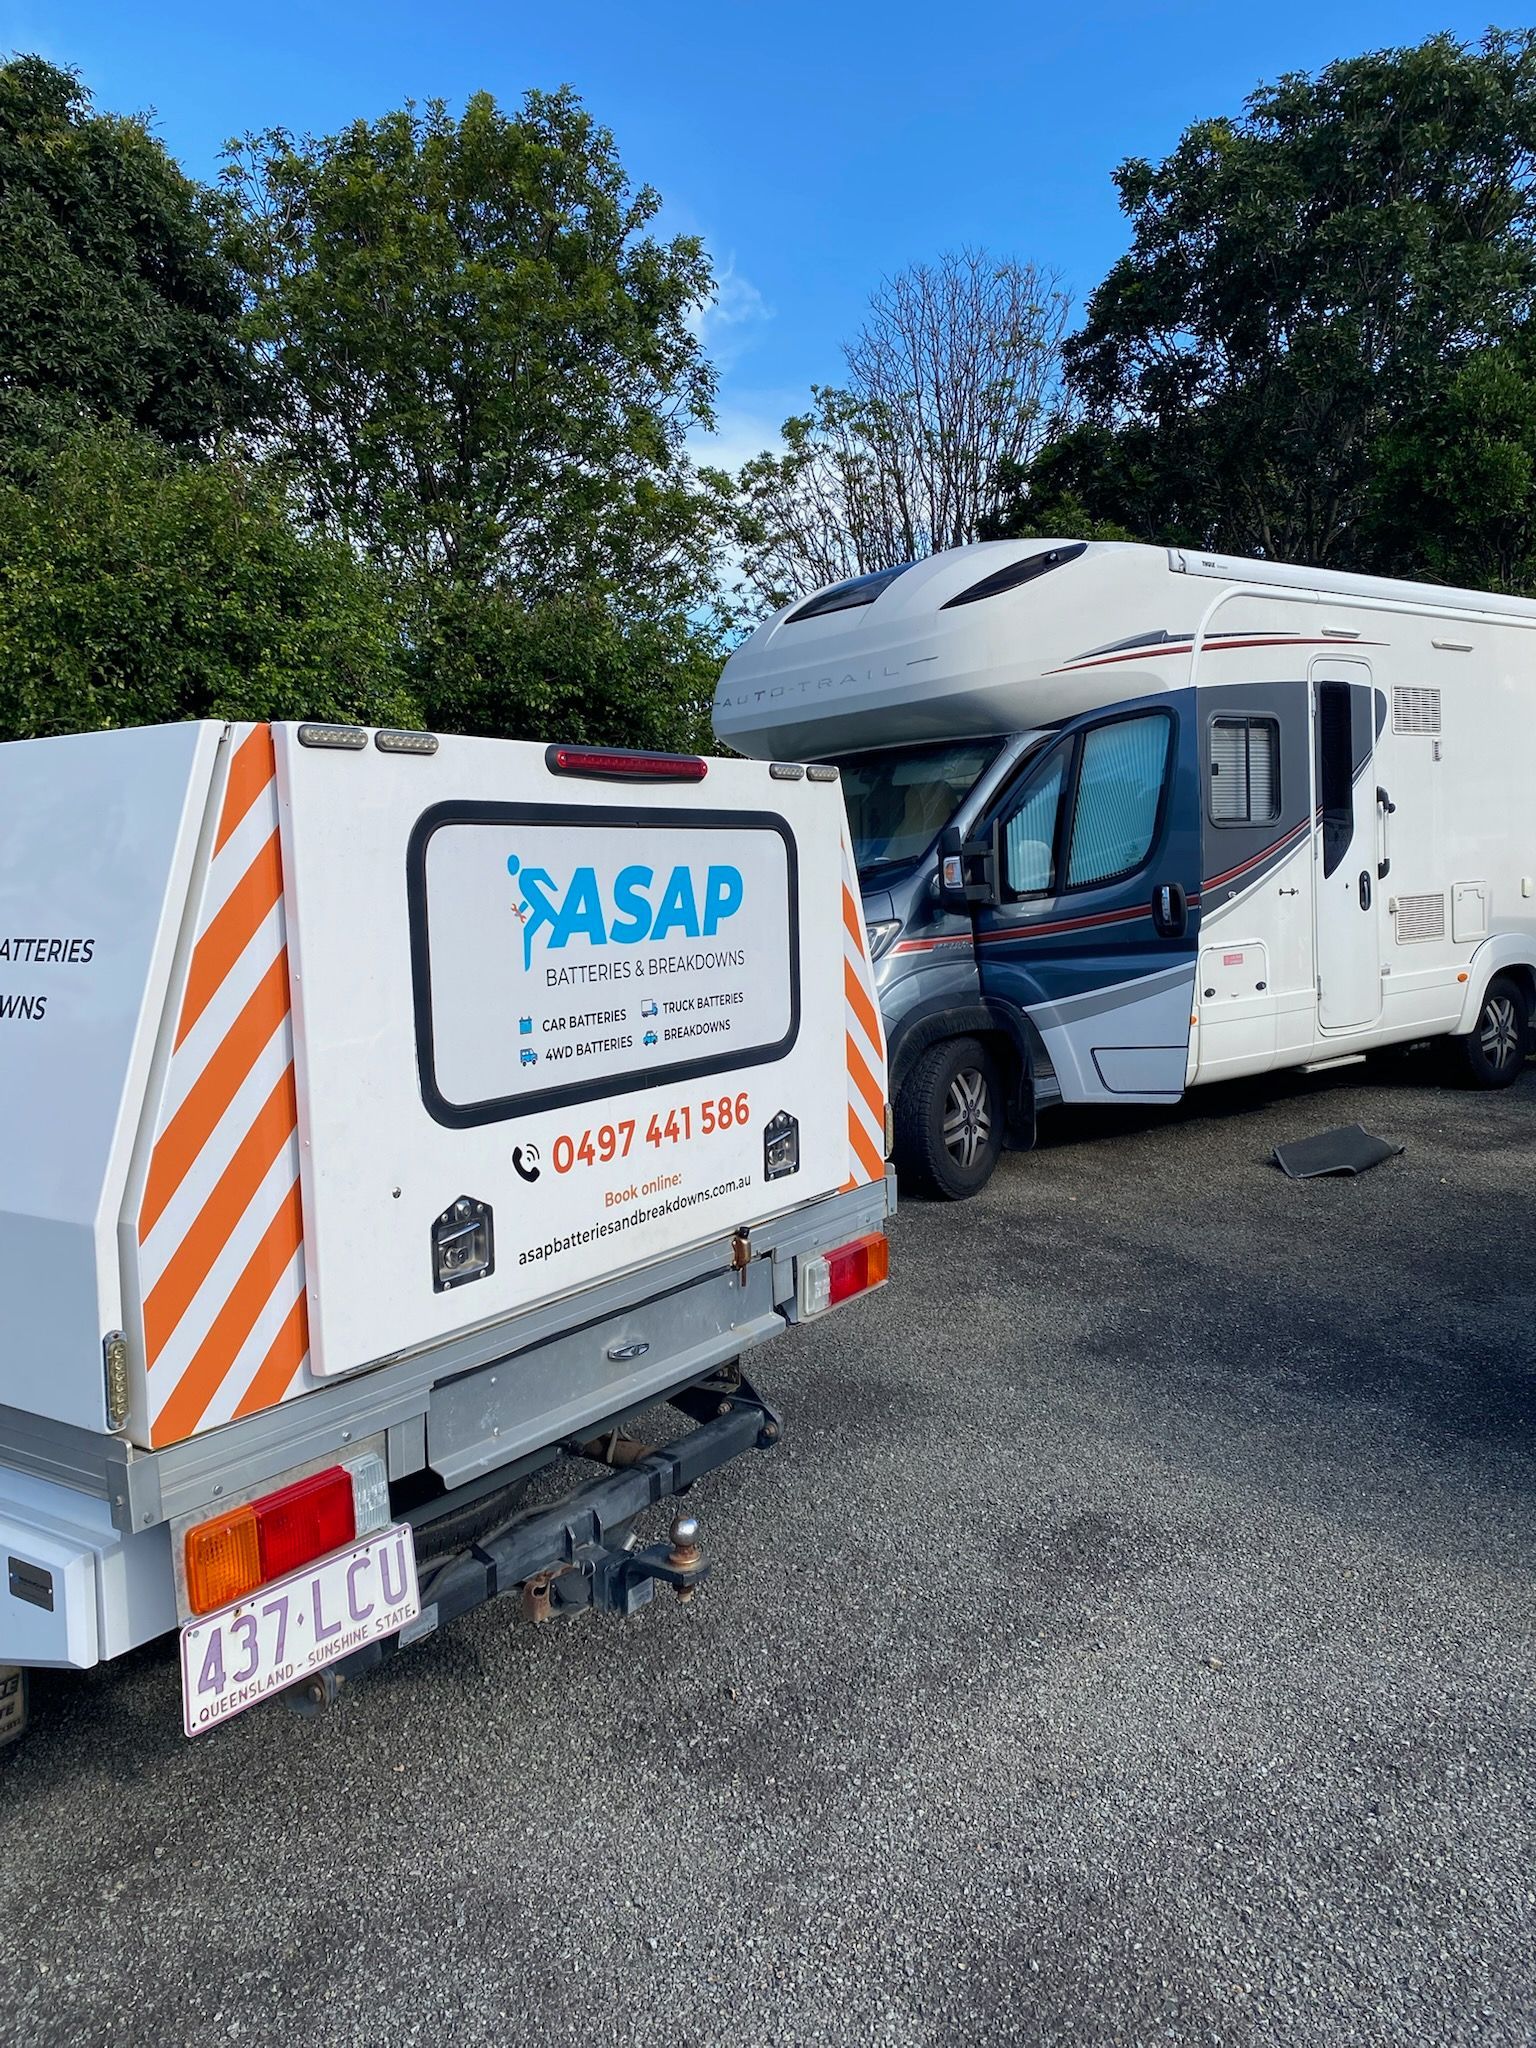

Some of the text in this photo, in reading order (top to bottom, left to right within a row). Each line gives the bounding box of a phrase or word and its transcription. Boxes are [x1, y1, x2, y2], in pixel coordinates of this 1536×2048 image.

[547, 865, 744, 948] ASAP
[546, 950, 745, 986] BATTERIES & BREAKDOWNS
[542, 1009, 627, 1032] CAR BATTERIES
[663, 992, 744, 1014] TRUCK BATTERIES
[664, 1019, 731, 1041] BREAKDOWNS
[545, 1036, 633, 1061] 4WD BATTERIES
[552, 1092, 750, 1174] 0497 441 586
[604, 1173, 682, 1208] Book online:
[518, 1175, 751, 1266] asapbatteriesandbreakdowns.com.au
[199, 1664, 294, 1721] QUEENSLAND
[308, 1625, 369, 1667] SUNSHINE
[375, 1604, 412, 1633] STATE
